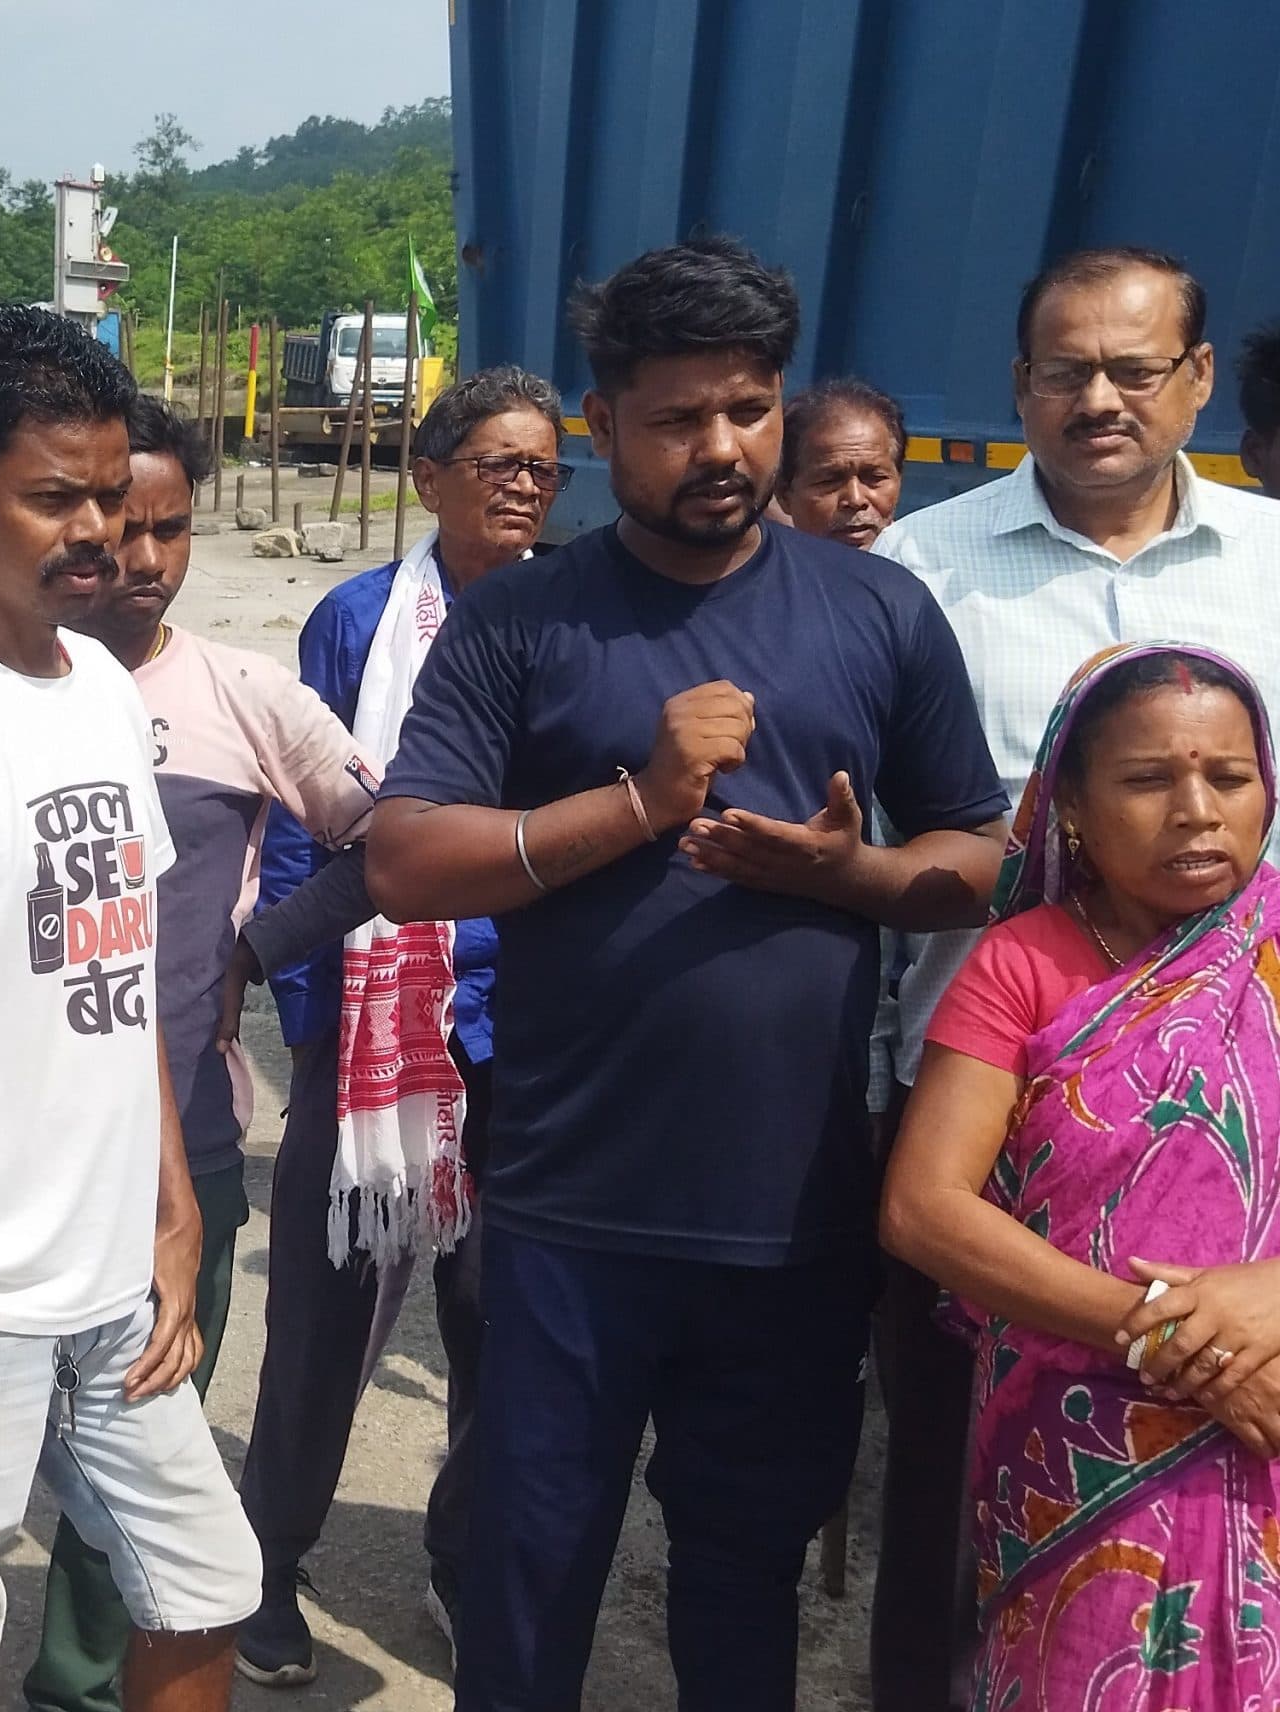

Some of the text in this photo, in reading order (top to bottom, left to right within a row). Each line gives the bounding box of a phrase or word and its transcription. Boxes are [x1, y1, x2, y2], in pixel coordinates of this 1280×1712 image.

[26, 781, 134, 843] कल
[65, 837, 122, 906] SE
[67, 891, 153, 966] DARU
[63, 959, 148, 1036] बंद
